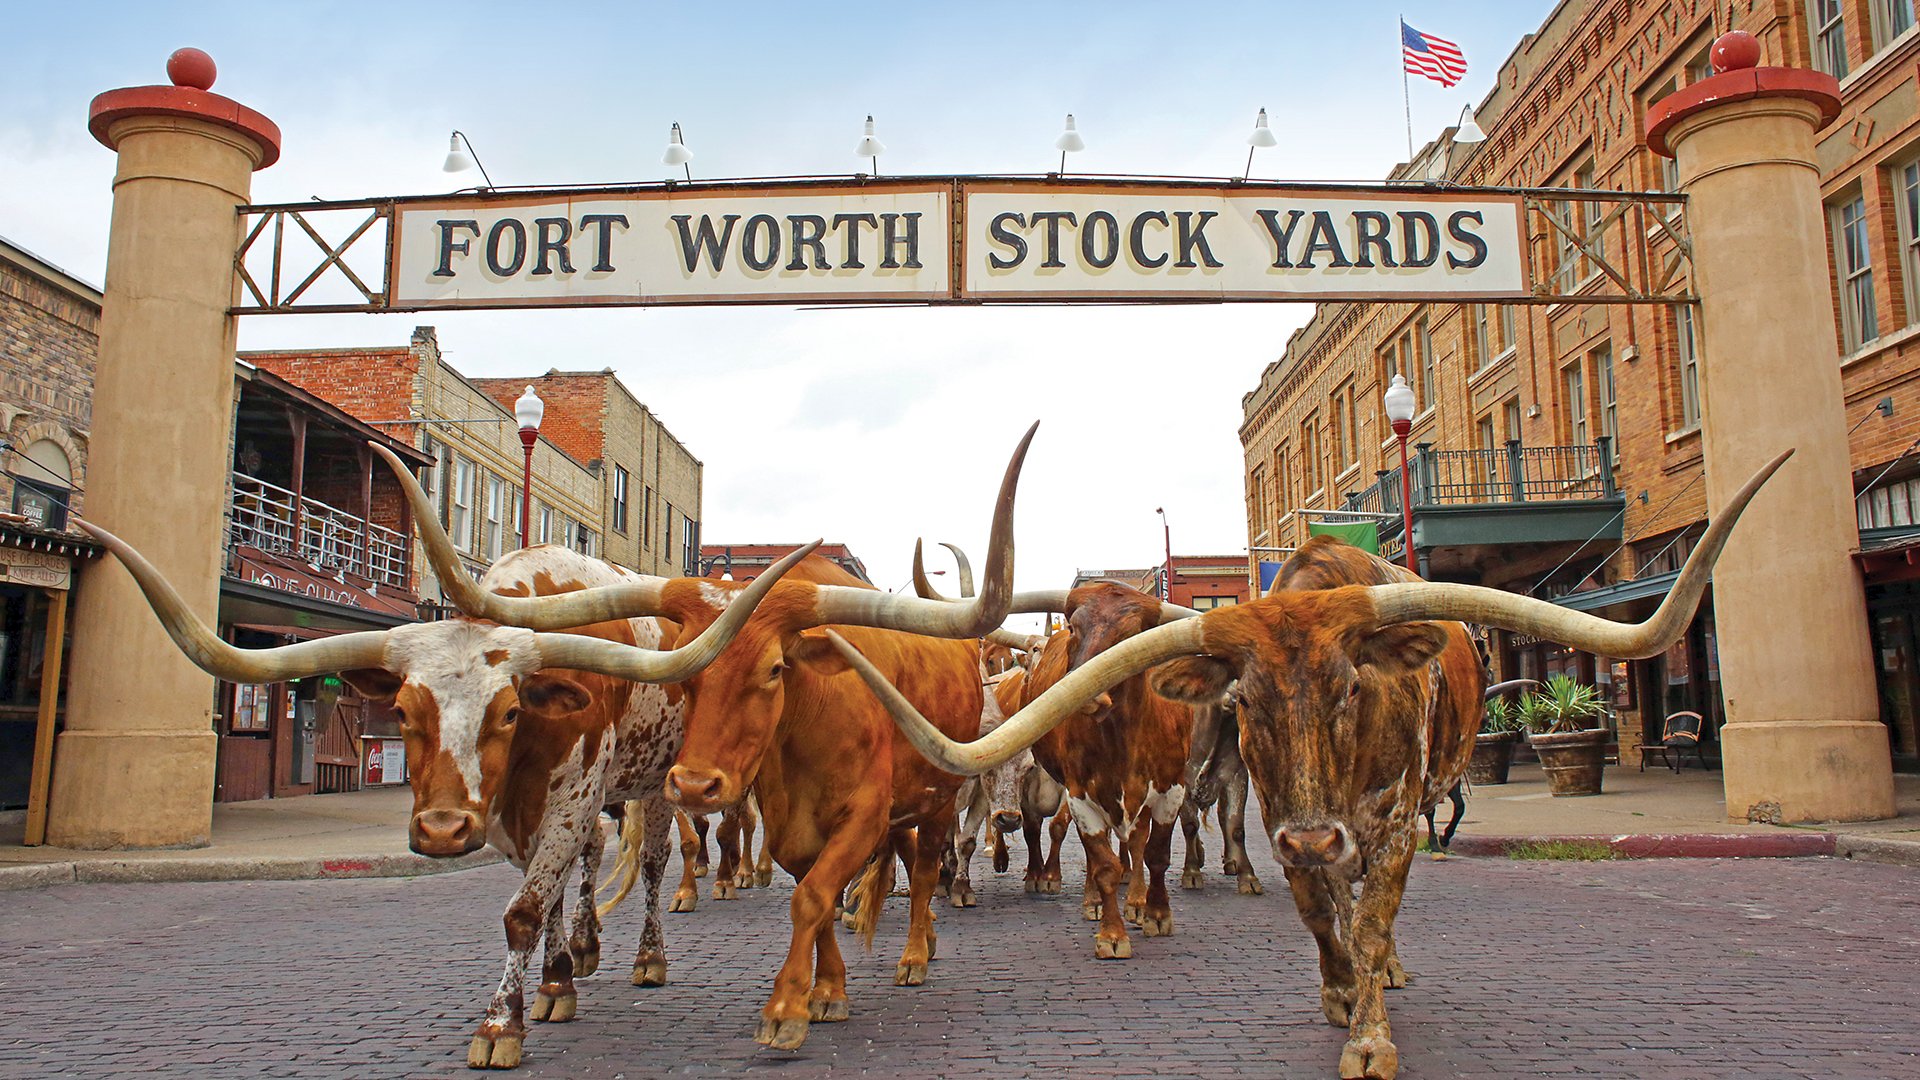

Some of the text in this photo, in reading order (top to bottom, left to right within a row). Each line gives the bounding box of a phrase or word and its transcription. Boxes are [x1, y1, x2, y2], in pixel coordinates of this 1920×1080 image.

[431, 209, 1489, 277] FORT WORTH STOCK YARDS
[1379, 538, 1403, 559] OTEL
[20, 553, 31, 564] OF
[34, 555, 66, 570] BLADES
[13, 566, 59, 583] KNIFE ALLEY
